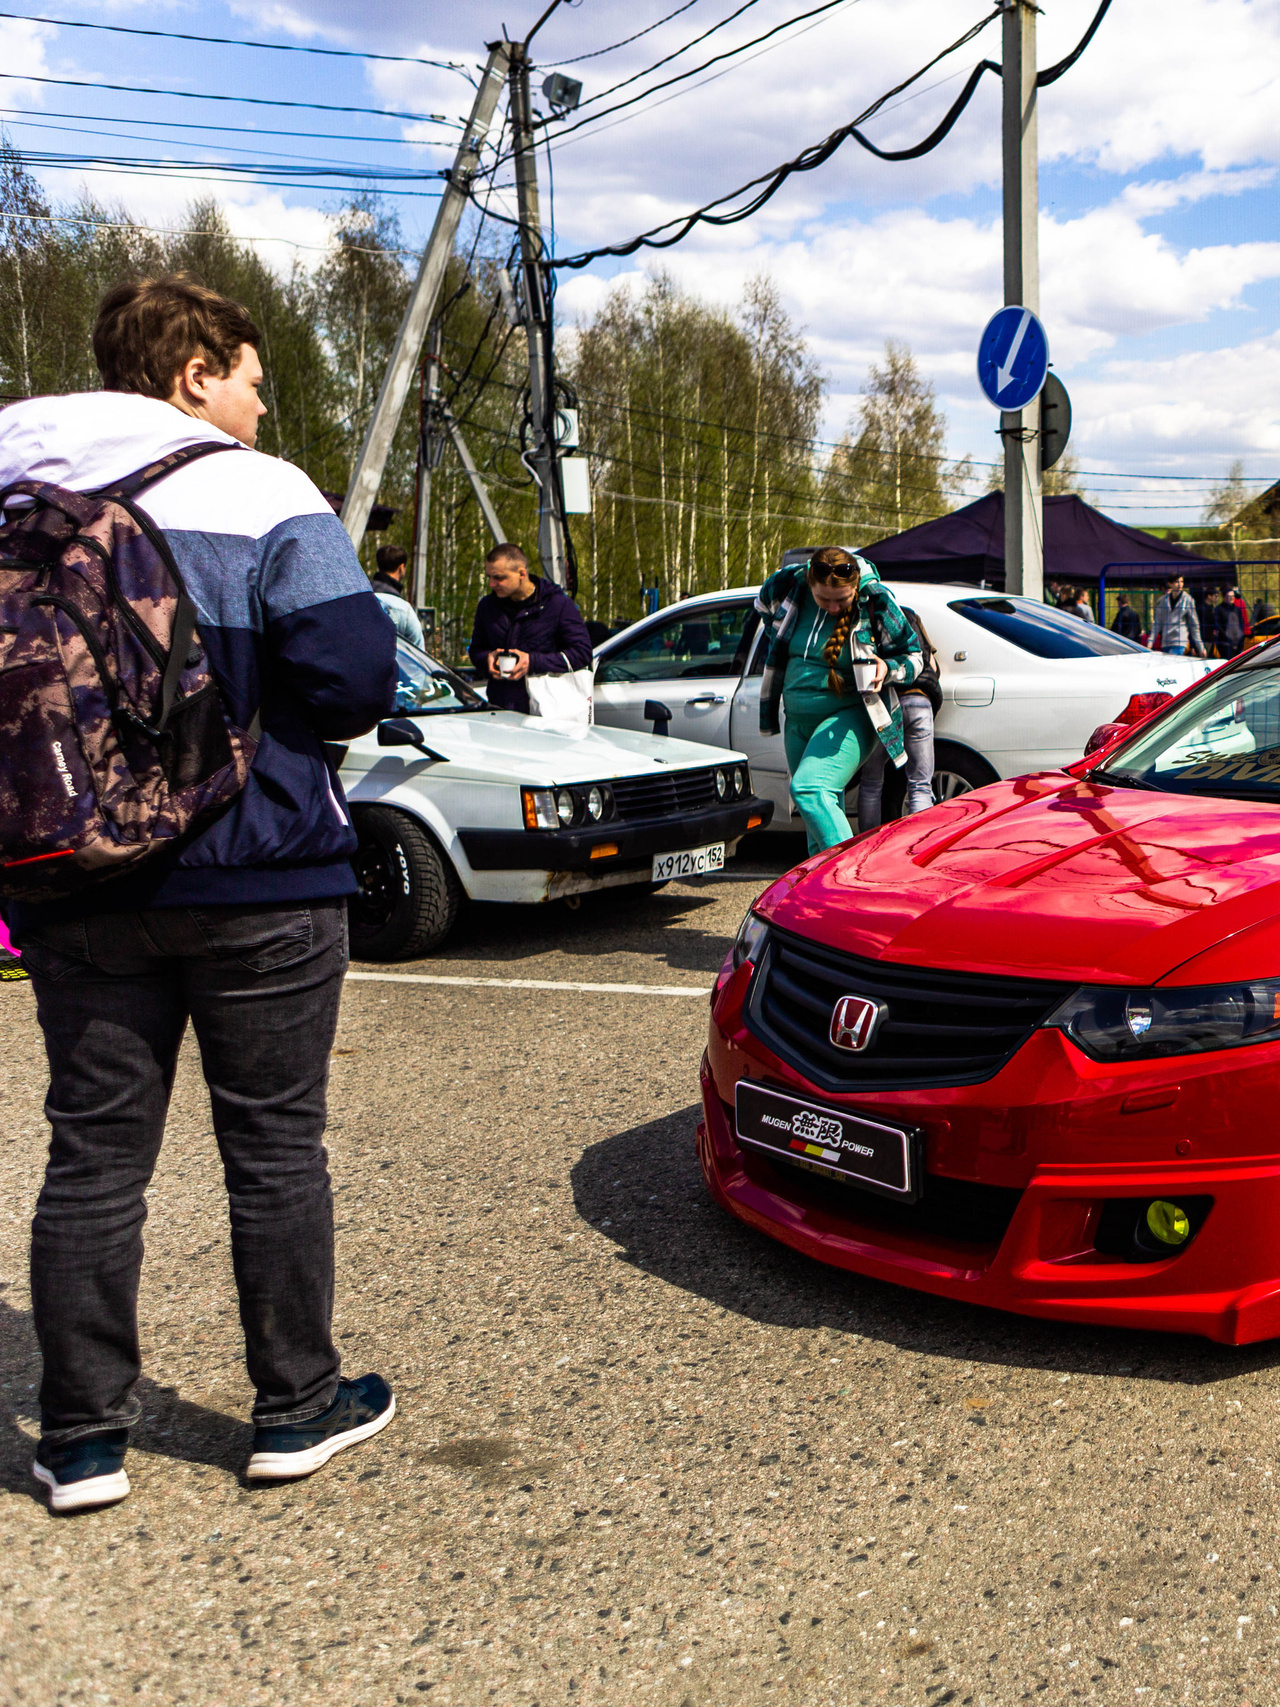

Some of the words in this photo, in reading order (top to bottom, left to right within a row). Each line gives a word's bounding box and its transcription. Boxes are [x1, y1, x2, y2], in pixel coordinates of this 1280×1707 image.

[52, 741, 69, 772] Carney
[62, 773, 79, 797] Road
[395, 843, 410, 895] TOYO
[707, 846, 722, 864] 152
[761, 1114, 792, 1131] MUGEN
[841, 1140, 875, 1158] POWER
